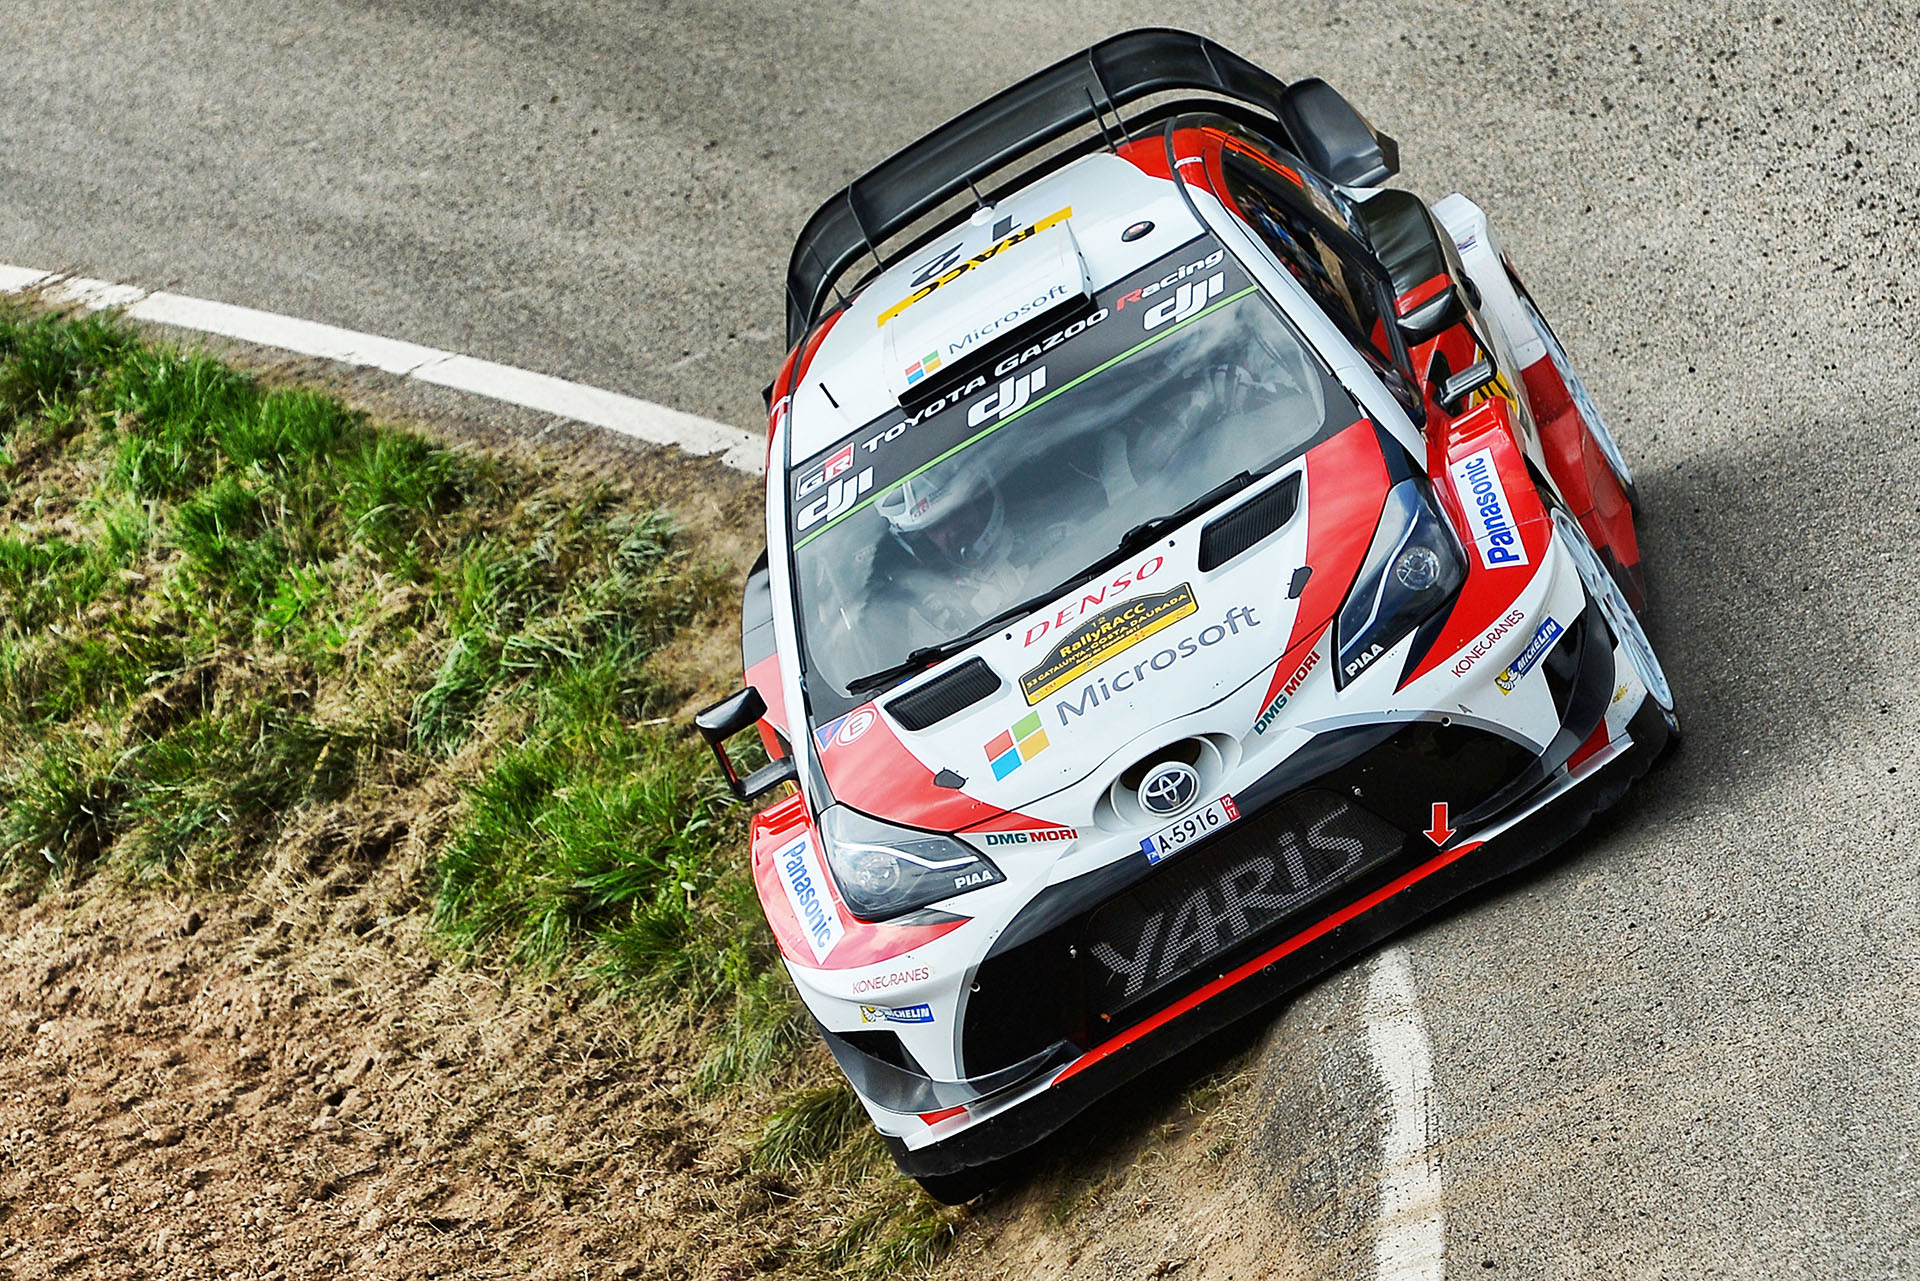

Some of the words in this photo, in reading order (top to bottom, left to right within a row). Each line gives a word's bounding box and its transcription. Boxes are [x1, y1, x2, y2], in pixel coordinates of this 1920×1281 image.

[912, 225, 1035, 303] RACC
[948, 284, 1068, 354] Microsoft
[861, 375, 987, 453] TOYOTA
[994, 307, 1109, 377] GAZOO
[1116, 249, 1224, 311] Racing
[798, 448, 853, 498] GR
[1464, 457, 1521, 565] Panasonic
[1023, 556, 1164, 648] DENSO
[1060, 602, 1147, 658] RallyRACC
[1130, 593, 1188, 627] DAURADA
[1056, 604, 1261, 726] Microsoft
[1344, 643, 1385, 677] PIAA
[1451, 609, 1525, 678] KONECRANES
[1517, 620, 1557, 671] MICHELIN
[1254, 695, 1288, 736] DMG
[1284, 650, 1321, 698] MORI
[1222, 796, 1233, 807] 12
[1226, 807, 1237, 819] 17
[985, 832, 1028, 847] DMG
[1030, 828, 1079, 843] MORI
[782, 840, 834, 949] Panasonic
[953, 870, 994, 890] PIAA
[852, 966, 929, 994] KONECRANES
